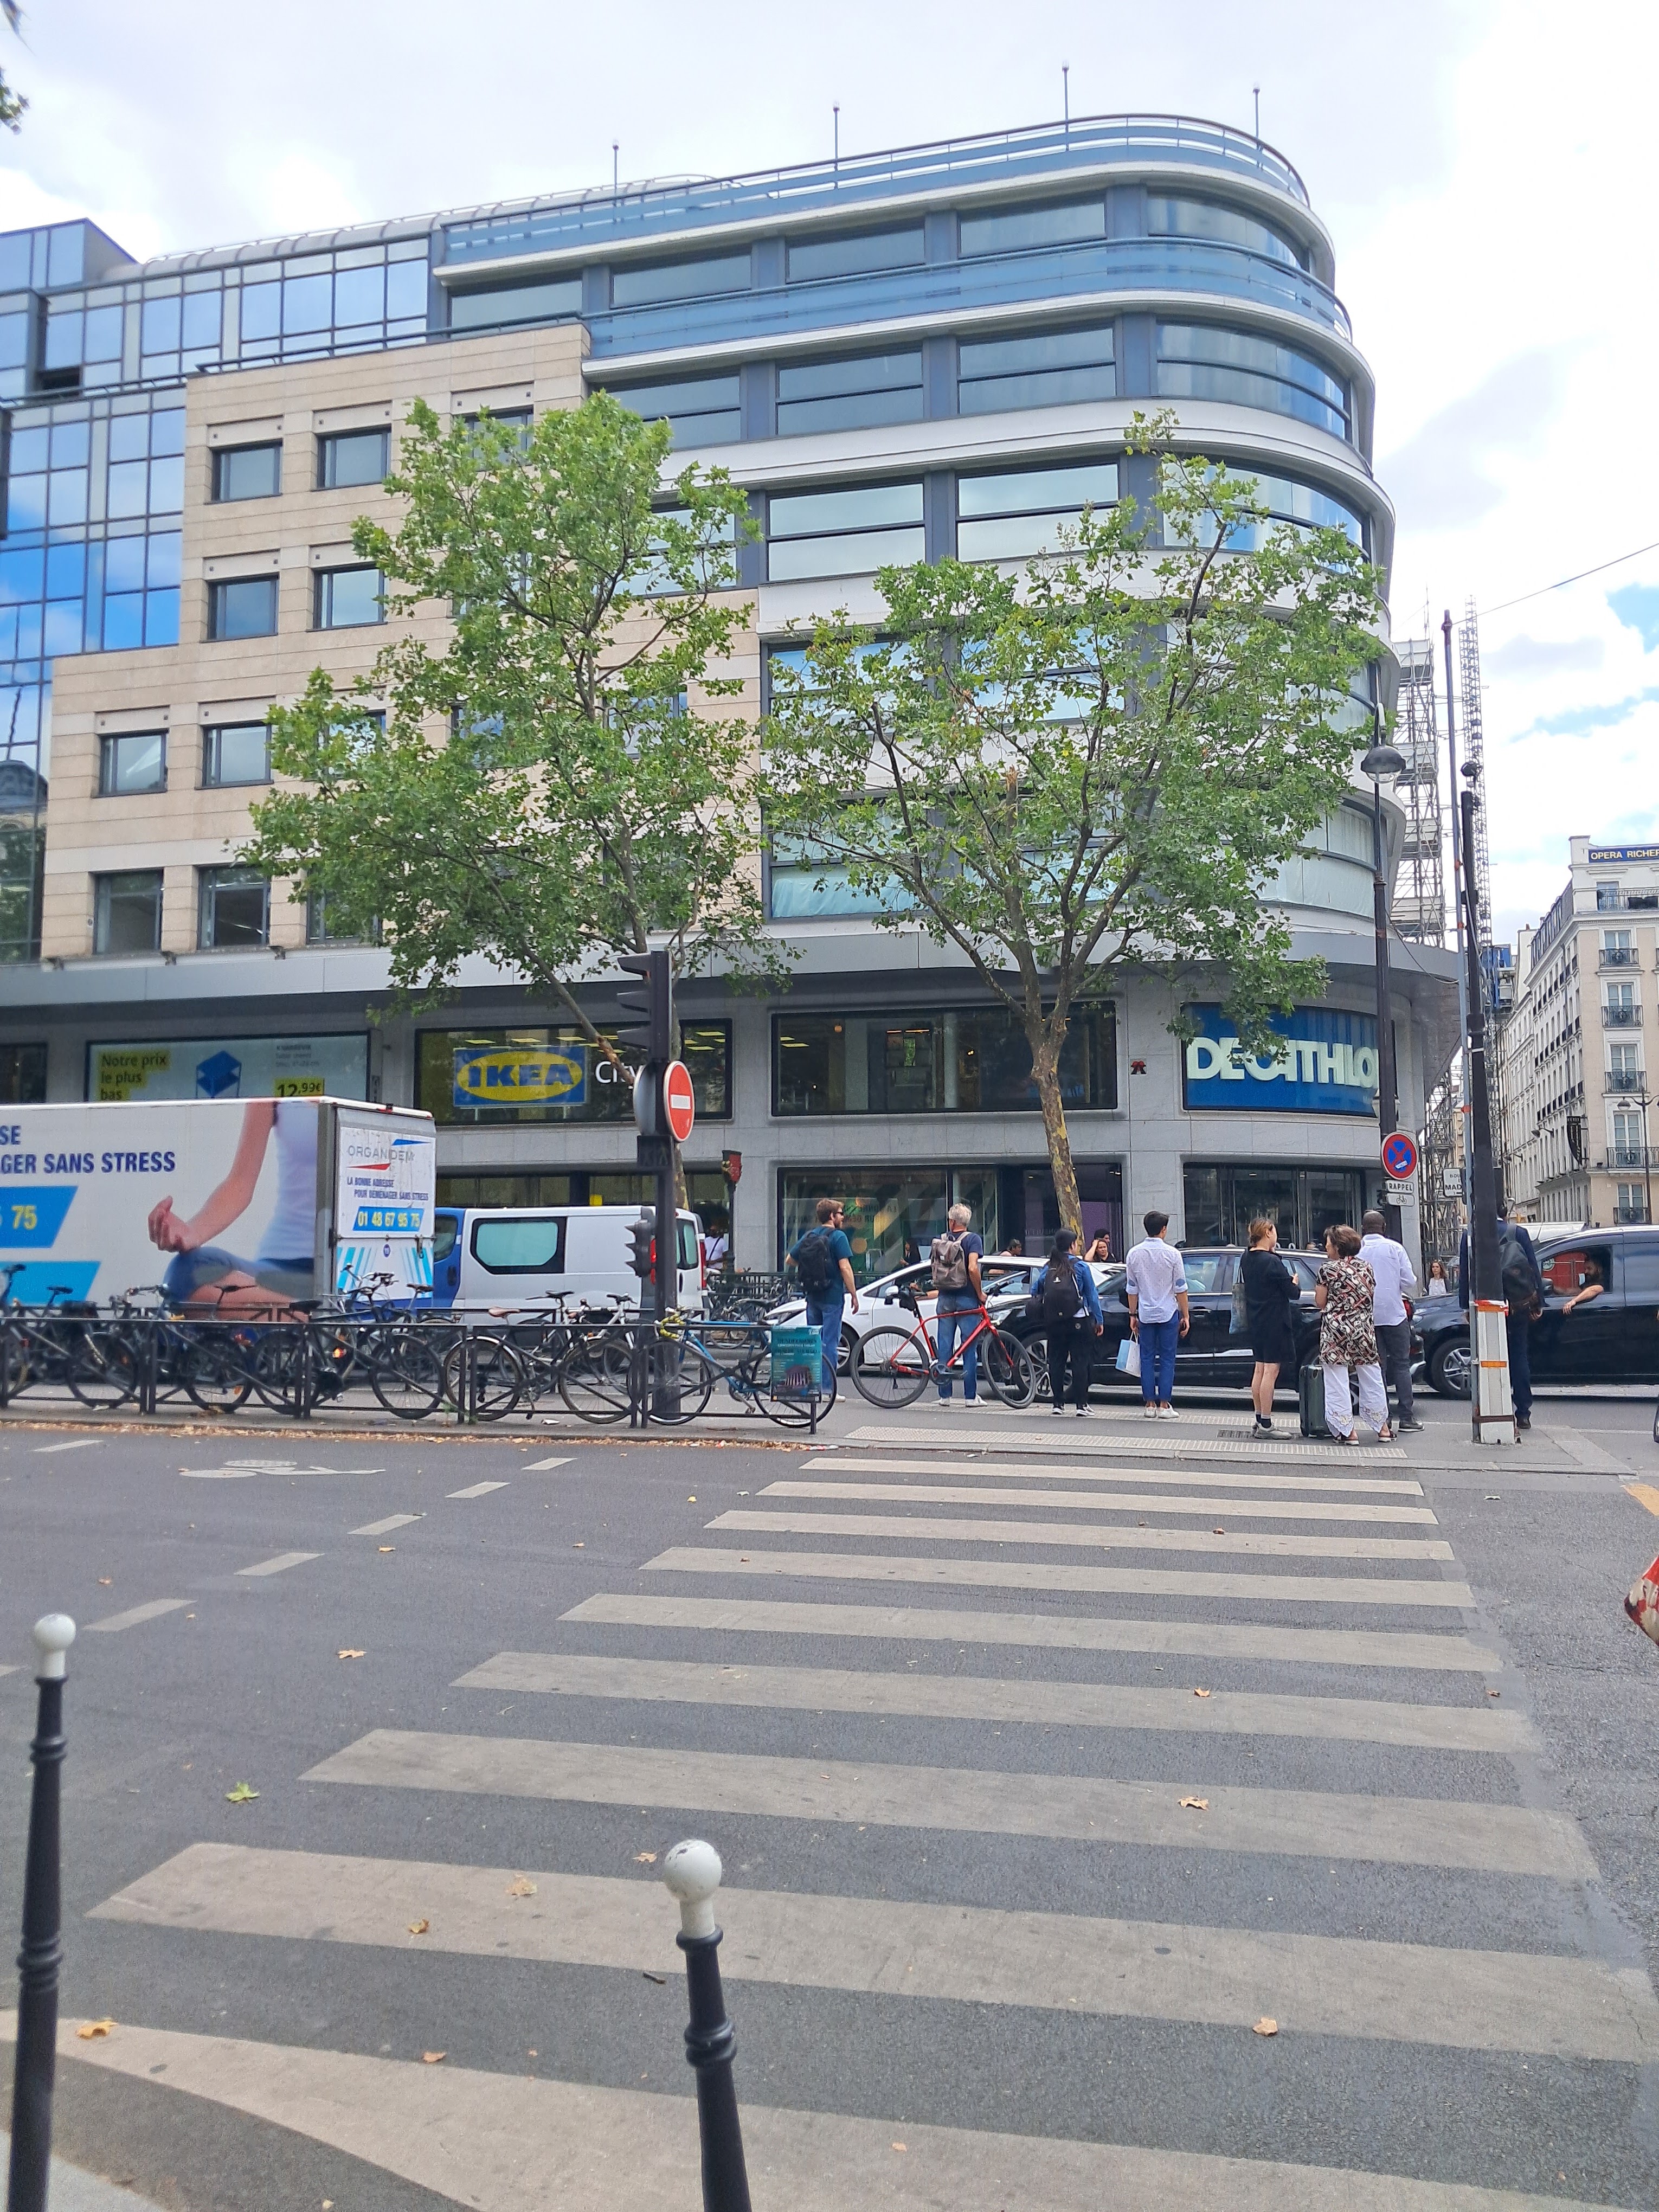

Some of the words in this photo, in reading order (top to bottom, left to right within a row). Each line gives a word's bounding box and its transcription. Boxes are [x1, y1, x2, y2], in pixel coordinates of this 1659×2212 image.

[1591, 851, 1623, 860] OPERA
[101, 1054, 138, 1067] Notre
[142, 1052, 166, 1069] prix
[101, 1072, 112, 1083] le
[115, 1071, 142, 1086] plus
[468, 1063, 575, 1088] IKEA
[101, 1088, 123, 1101] bas
[0, 1125, 21, 1145] SE
[1, 1154, 37, 1174] GER
[44, 1153, 94, 1173] SANS
[101, 1151, 176, 1173] STRESS
[1389, 1182, 1413, 1191] RAPPEL
[11, 1205, 37, 1230] 75
[358, 1211, 368, 1227] 01
[385, 1212, 395, 1227] 67
[410, 1213, 420, 1227] 75
